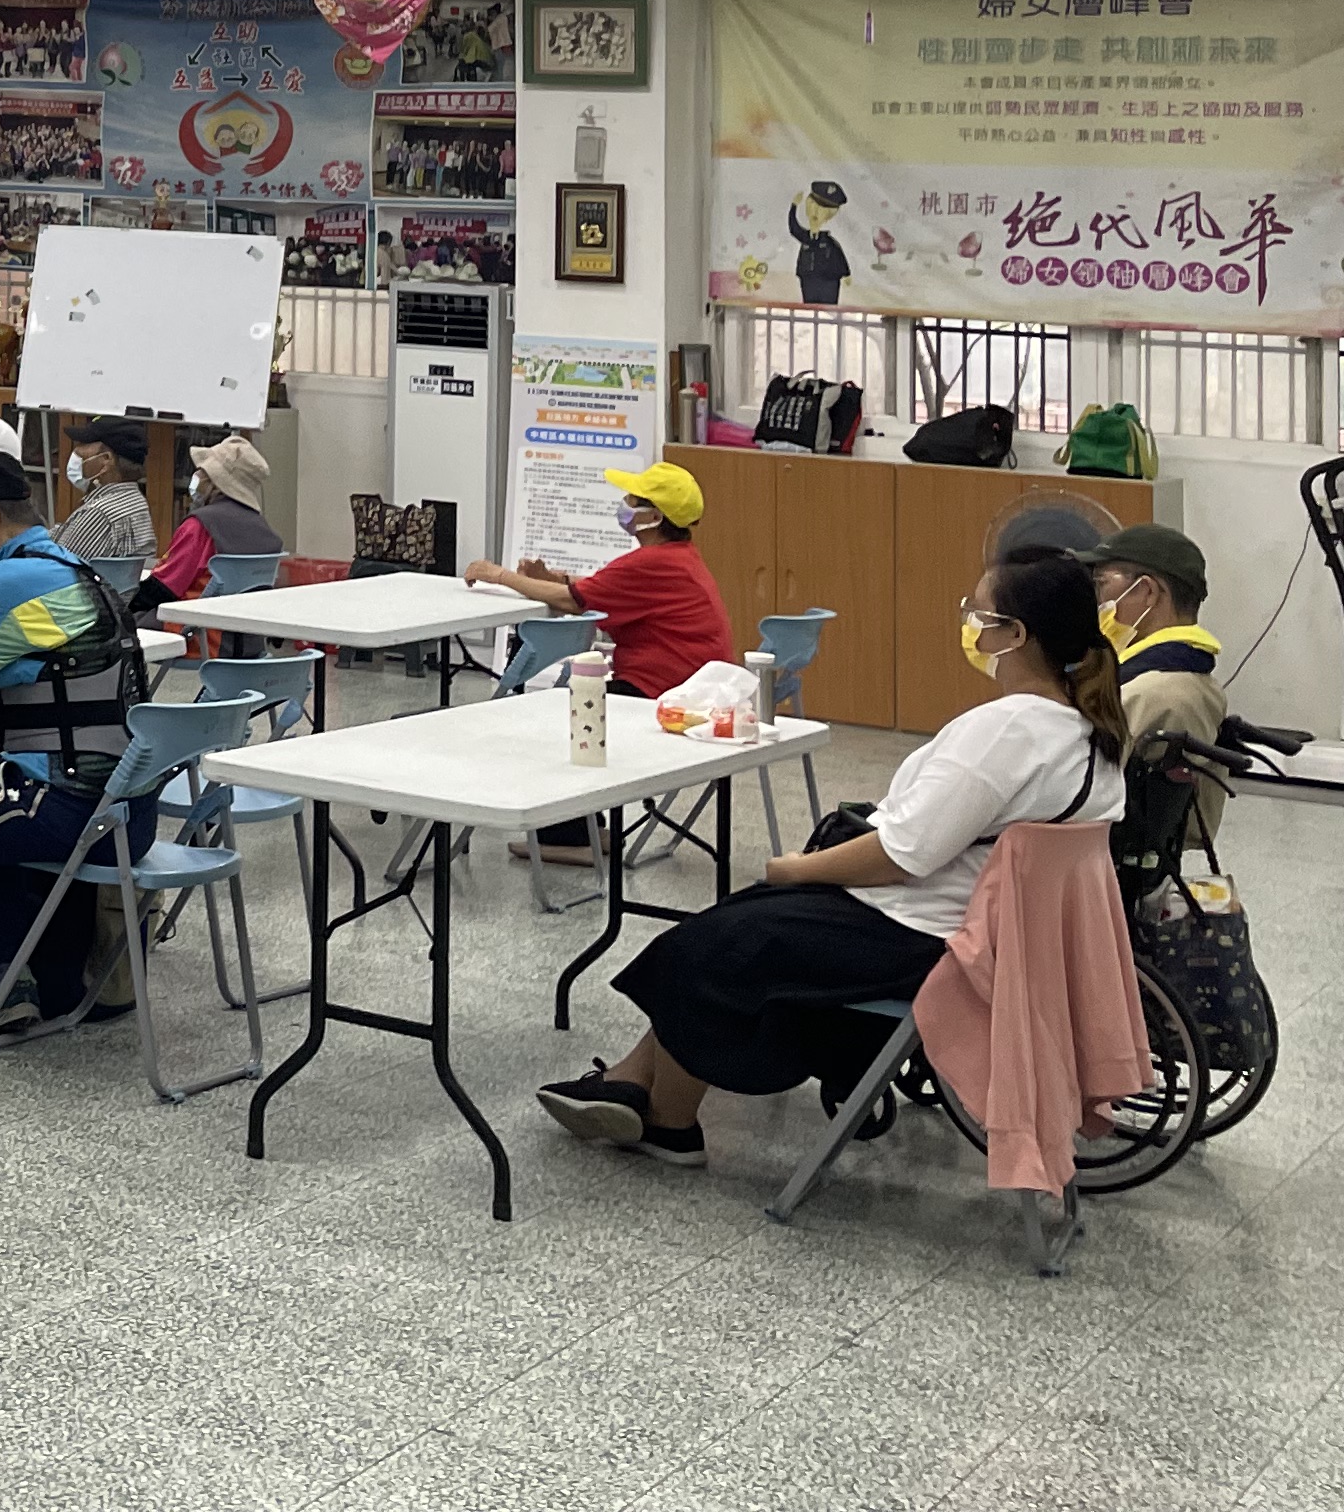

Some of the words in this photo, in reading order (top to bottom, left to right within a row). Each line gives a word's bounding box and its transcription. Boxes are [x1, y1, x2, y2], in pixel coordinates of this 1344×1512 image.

[918, 191, 998, 216] 桃園市
[1003, 257, 1249, 293] 婦女領袖層峰會
